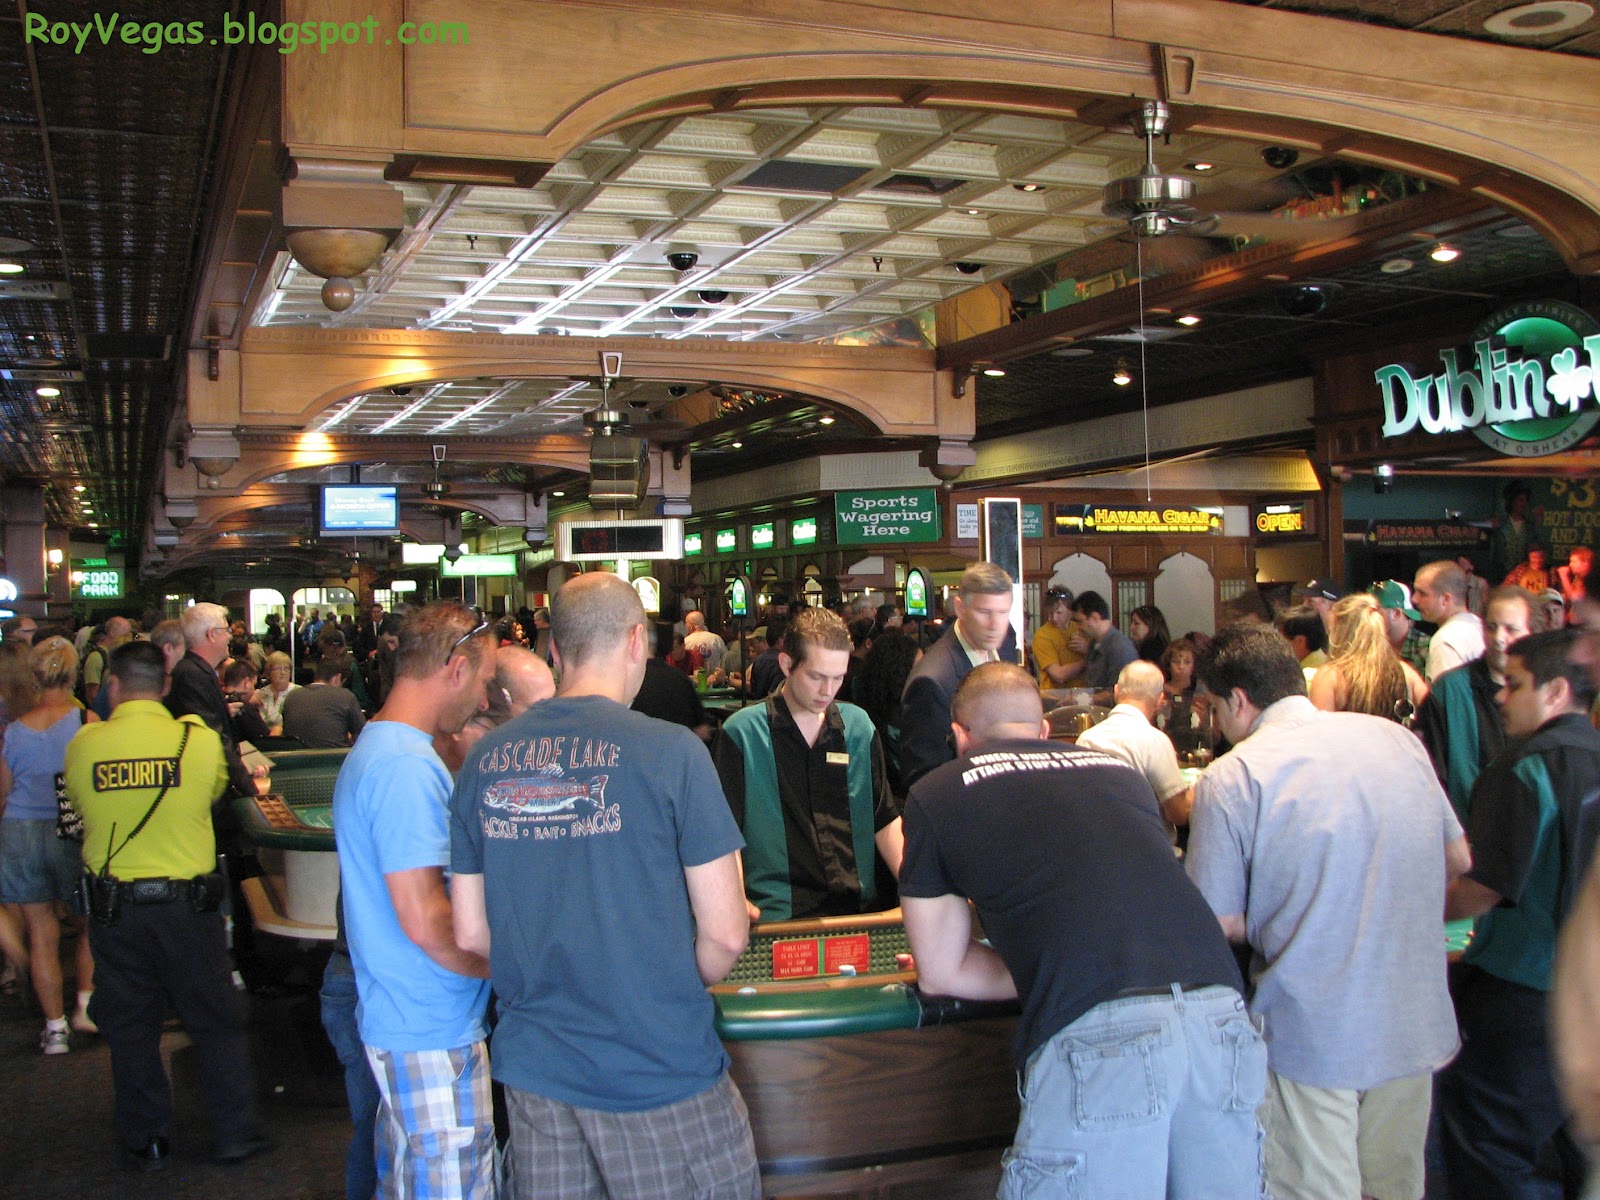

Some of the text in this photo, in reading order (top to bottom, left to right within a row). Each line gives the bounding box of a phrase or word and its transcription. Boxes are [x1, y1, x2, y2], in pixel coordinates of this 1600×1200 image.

[1374, 338, 1550, 438] Dublin
[1492, 437, 1508, 450] AT
[851, 495, 918, 511] Sports
[839, 508, 933, 525] Wagering
[958, 509, 976, 517] TIME
[1094, 508, 1210, 524] HAVANA CIGAR
[1543, 511, 1571, 526] HOT
[1256, 512, 1302, 532] OPEN
[862, 525, 910, 537] Here
[1376, 525, 1434, 539] HAVANA
[82, 571, 118, 584] FOOD
[82, 584, 119, 597] PARK
[479, 736, 621, 773] CASCADE LAKE
[969, 752, 1019, 766] WHERE
[96, 759, 178, 789] SECURITY
[961, 760, 1015, 786] ATTACK
[1014, 759, 1061, 770] STOPS
[1059, 757, 1073, 768] A
[534, 825, 560, 840] BAIT
[570, 802, 622, 838] SNACKS
